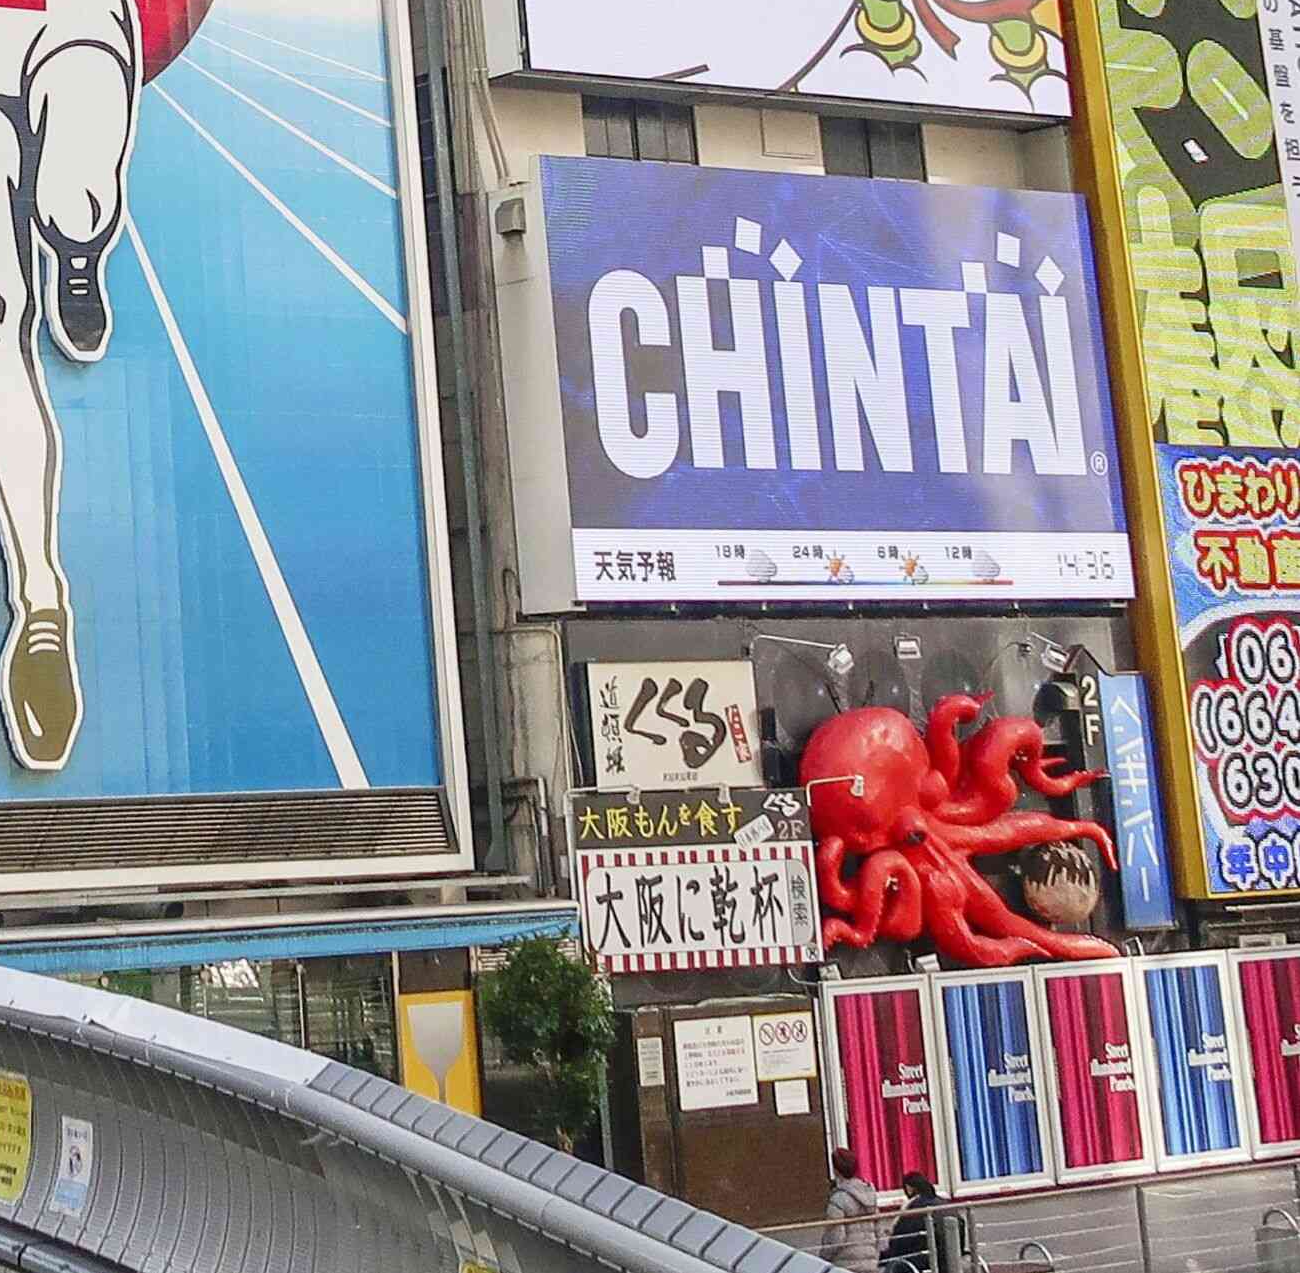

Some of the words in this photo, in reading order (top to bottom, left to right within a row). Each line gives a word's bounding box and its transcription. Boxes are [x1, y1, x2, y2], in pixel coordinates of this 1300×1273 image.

[588, 218, 1089, 480] CHINTAI
[594, 549, 677, 584] 天気予報
[624, 677, 726, 769] くくる
[1080, 676, 1102, 747] 2F
[778, 819, 805, 841] 2F
[595, 864, 786, 950] 大阪に乾杯
